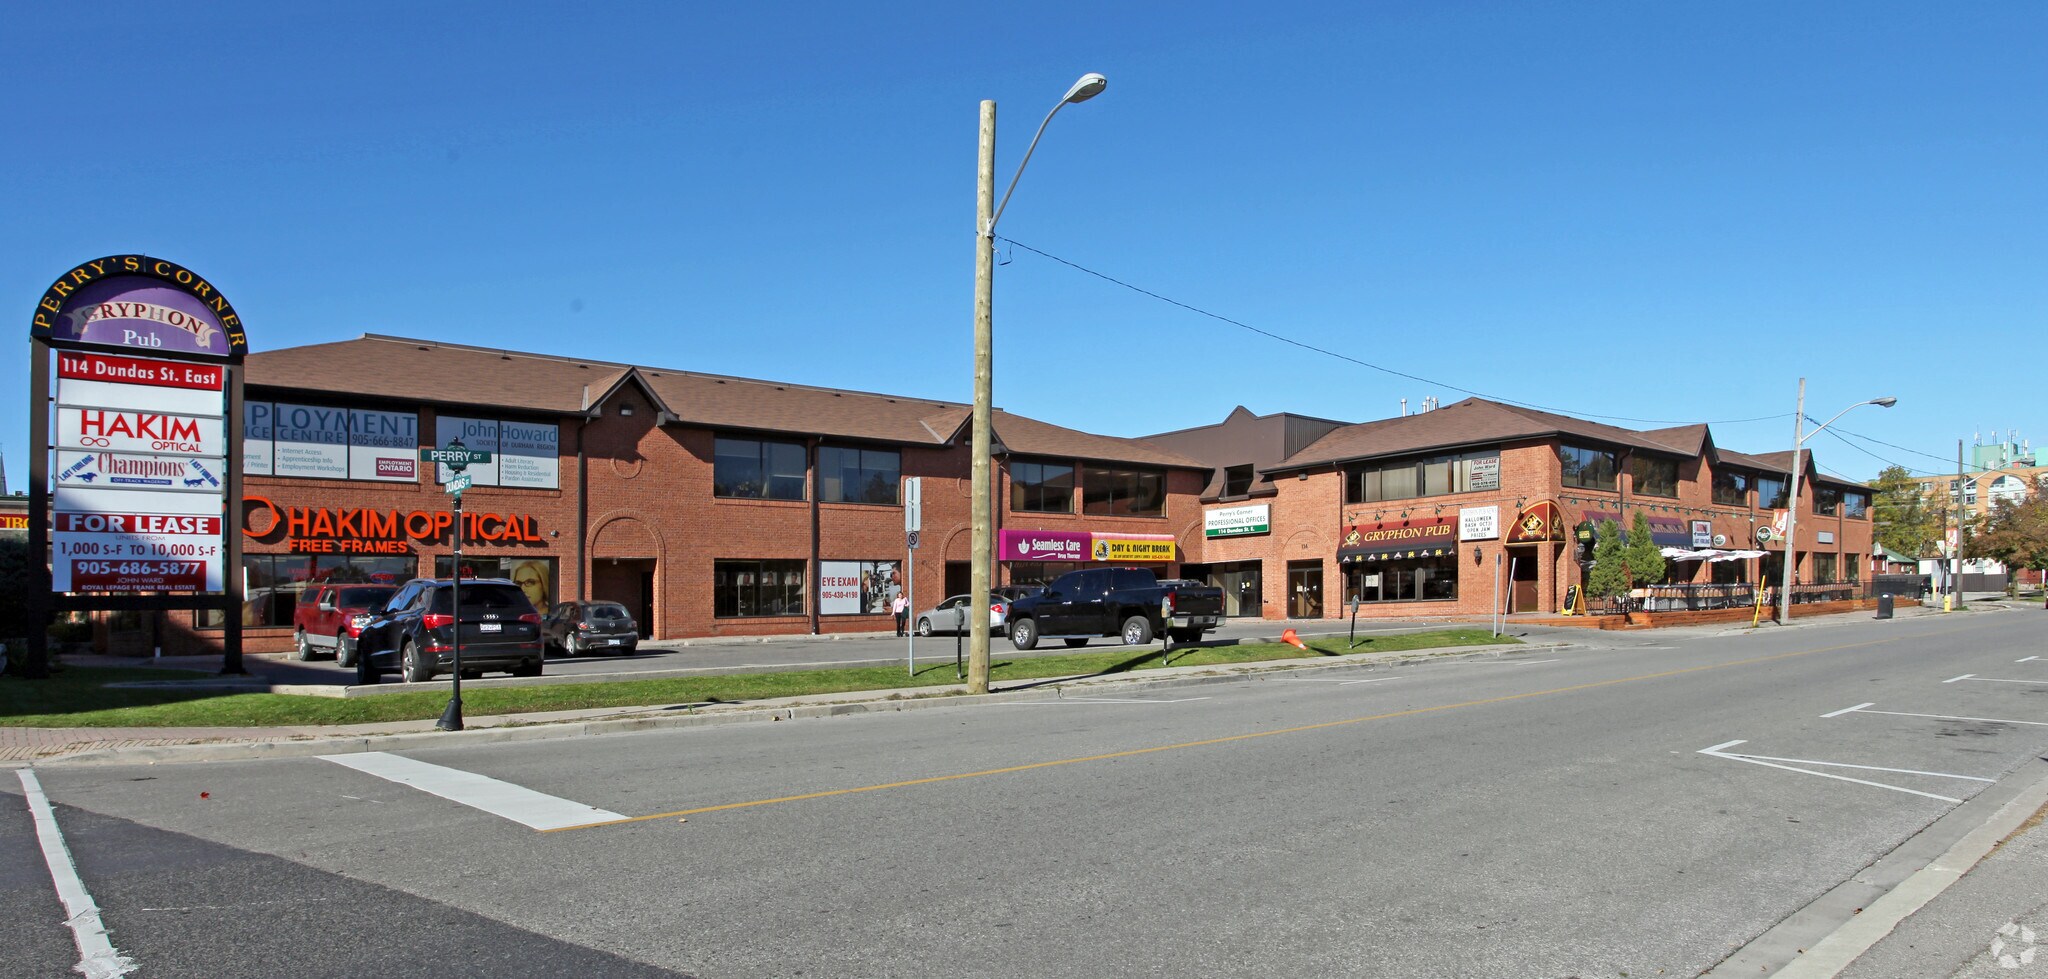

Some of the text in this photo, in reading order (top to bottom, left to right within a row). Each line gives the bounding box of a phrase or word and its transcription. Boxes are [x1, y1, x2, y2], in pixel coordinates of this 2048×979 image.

[34, 256, 245, 347] PERRY'S CORNER
[84, 301, 204, 334] GRYPHON
[123, 329, 162, 348] Pub
[62, 358, 216, 385] 114 Dundas St. East
[80, 409, 201, 442] HAKIM
[243, 405, 416, 437] PLOYMENT
[280, 428, 343, 444] CENTRE
[460, 421, 557, 442] John Howard
[151, 440, 202, 453] OPTICAL
[352, 434, 415, 447] 905-666-8847
[282, 447, 304, 455] Internet
[431, 450, 471, 461] PERRY
[97, 452, 186, 478] Champions
[282, 463, 345, 473] Employment Workshops
[378, 464, 413, 472] ONTARIO
[446, 478, 465, 493] DUNDAS
[68, 514, 209, 534] FOR LEASE
[288, 505, 541, 542] HAKIM OPTICAL
[1208, 516, 1266, 527] PROFESSIONAL OFFICES
[1364, 524, 1451, 542] GRYPHON PUB
[61, 542, 216, 558] 1,000 S-F TO 10,000 S-F
[288, 539, 408, 554] FREE FRAMES
[1032, 538, 1064, 551] Seamless
[1066, 539, 1081, 551] Care
[1112, 543, 1125, 552] DAY
[1132, 544, 1151, 553] NIGHT
[1152, 545, 1171, 553] BREAK
[77, 561, 200, 575] 905-686-5877
[822, 576, 858, 587] EYE EXAM
